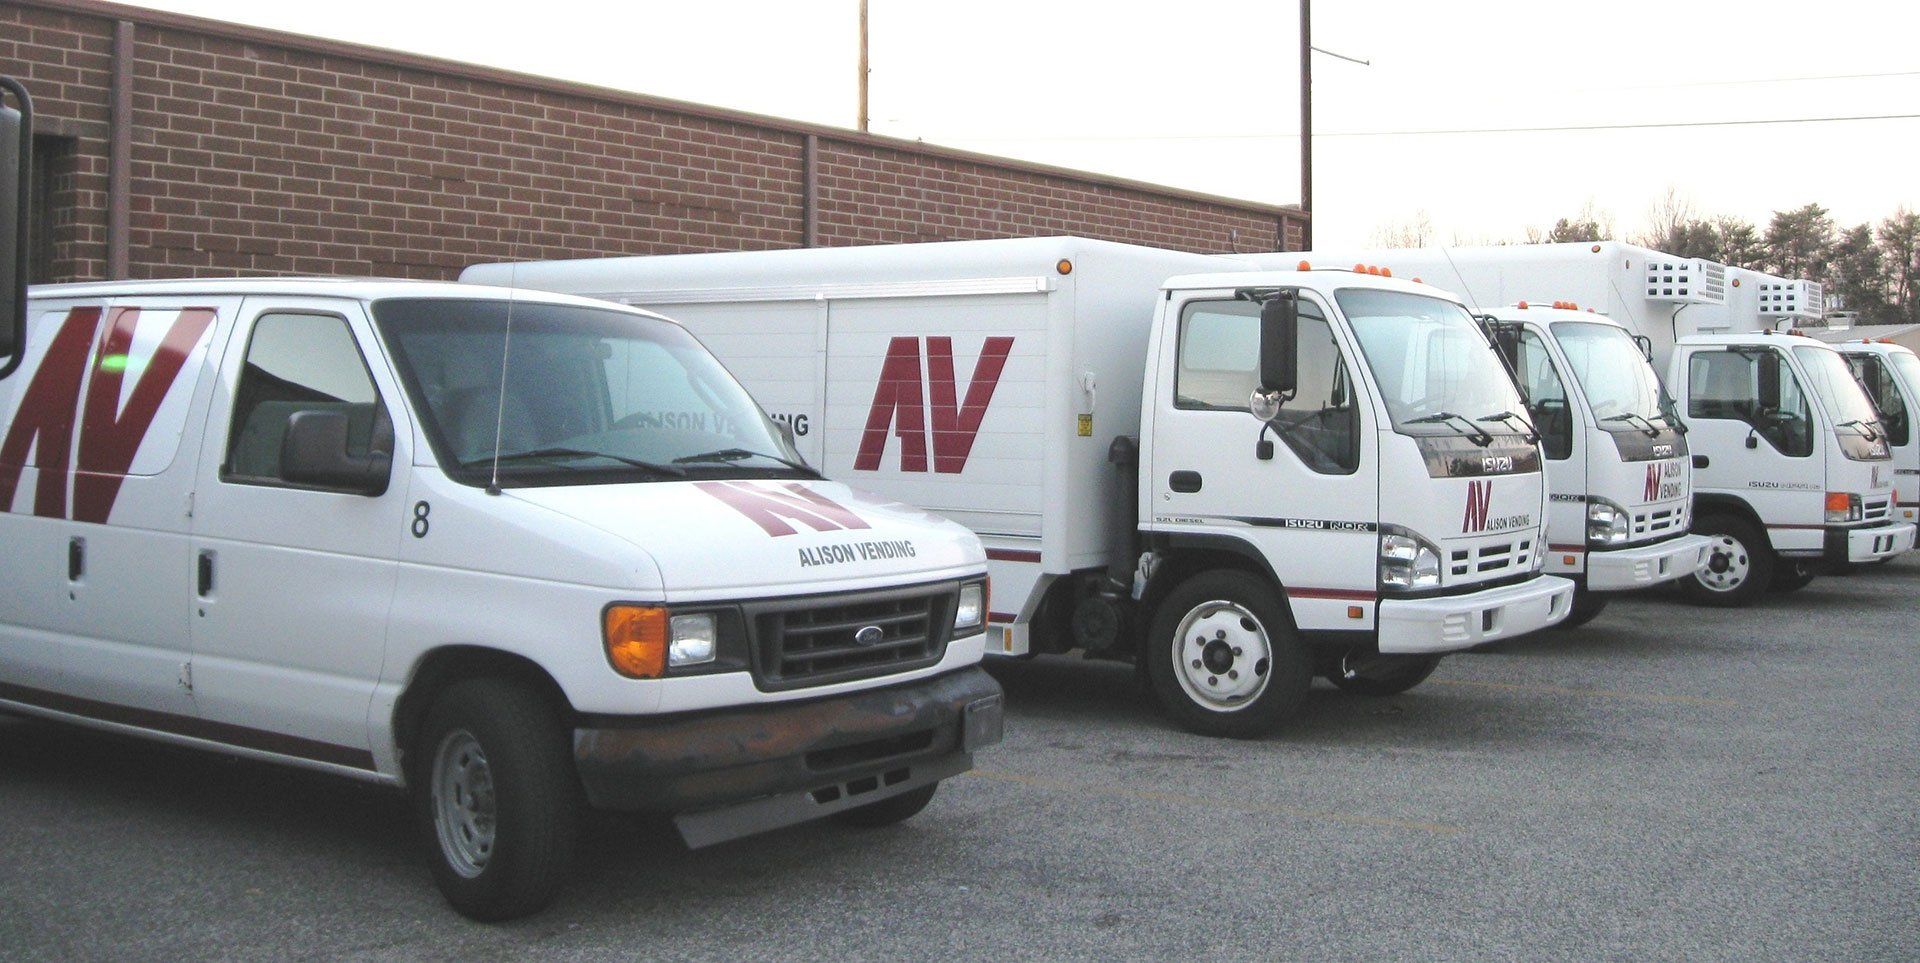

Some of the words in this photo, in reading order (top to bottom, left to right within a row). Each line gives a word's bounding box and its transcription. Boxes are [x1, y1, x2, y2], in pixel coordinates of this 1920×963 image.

[0, 306, 218, 524] AV
[853, 336, 1015, 474] AV
[1482, 456, 1513, 472] ISUZU
[1644, 463, 1661, 501] AV
[411, 500, 430, 539] 8
[1285, 519, 1324, 529] ISUZU
[1462, 480, 1492, 533] AV
[1486, 518, 1508, 531] ALISON
[1508, 514, 1530, 529] VENDING
[798, 543, 856, 568] ALISON
[854, 540, 917, 562] VENDING
